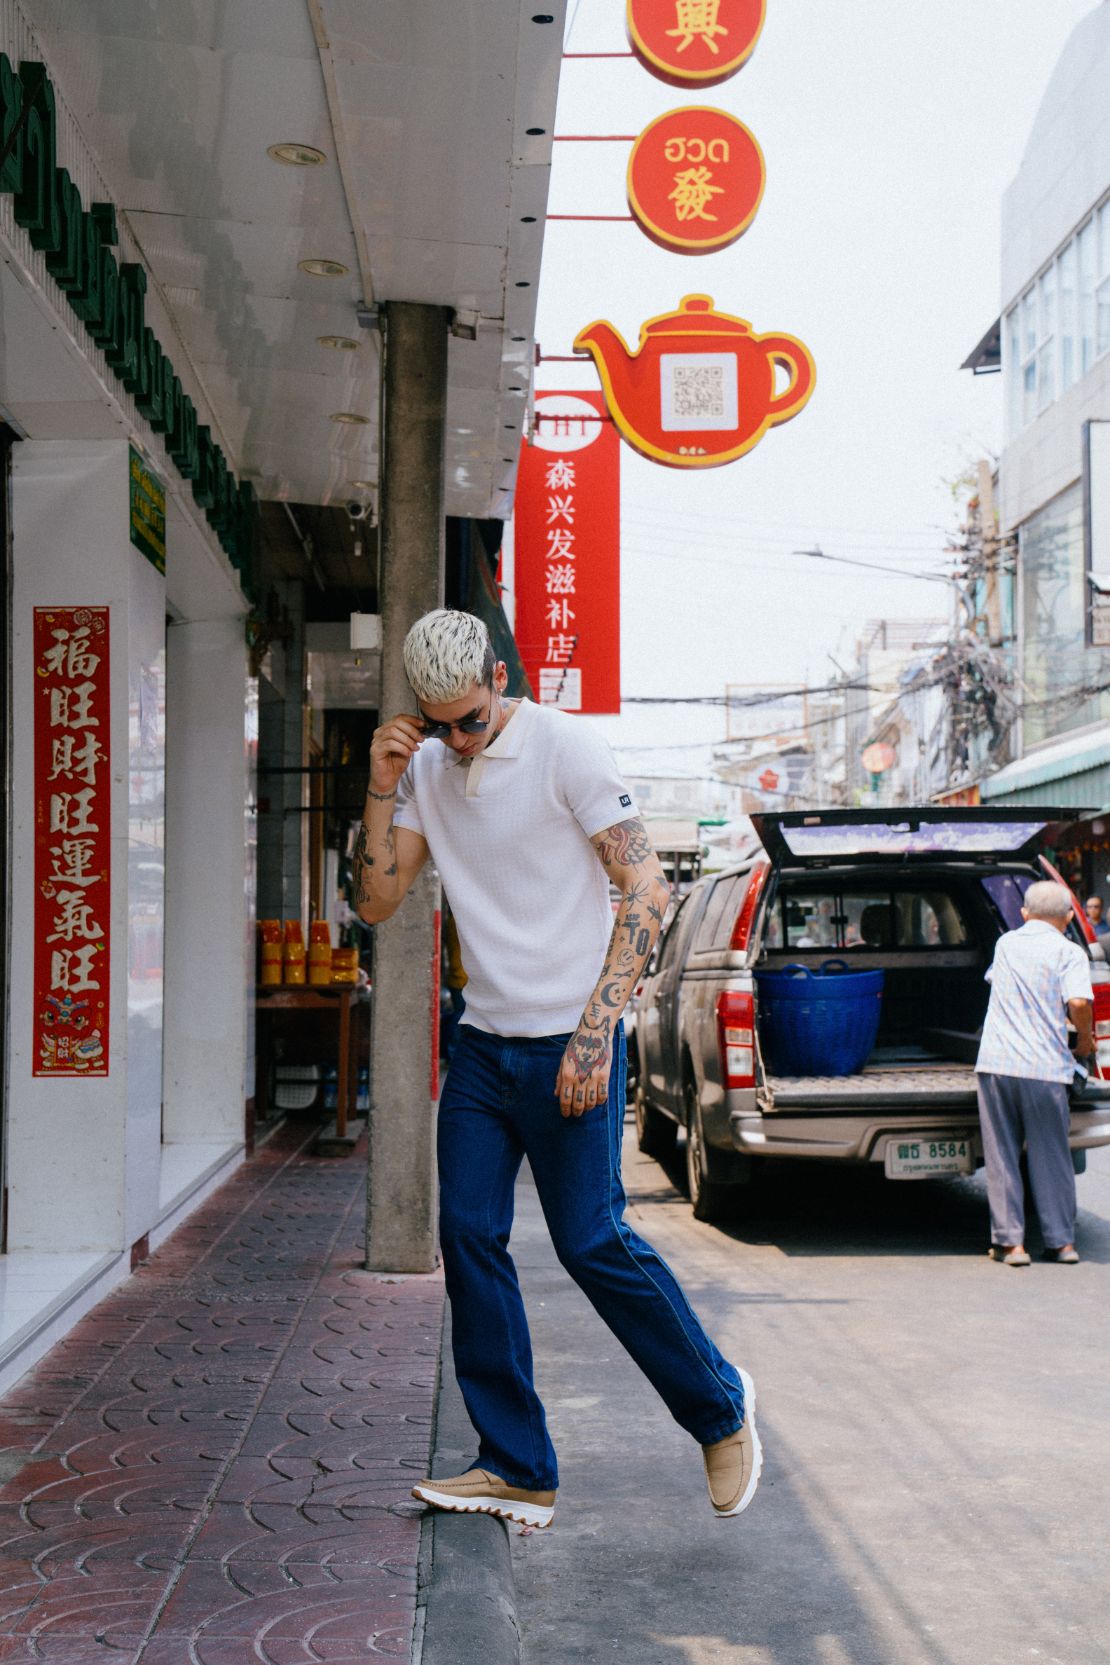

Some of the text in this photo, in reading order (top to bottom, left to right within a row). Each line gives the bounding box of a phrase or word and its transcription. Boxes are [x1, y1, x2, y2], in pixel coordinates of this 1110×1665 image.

[668, 166, 725, 222] 發
[545, 459, 576, 664] 森兴发滋补店
[43, 625, 105, 994] 福旺財旺運氣旺
[929, 1142, 966, 1159] 8584
